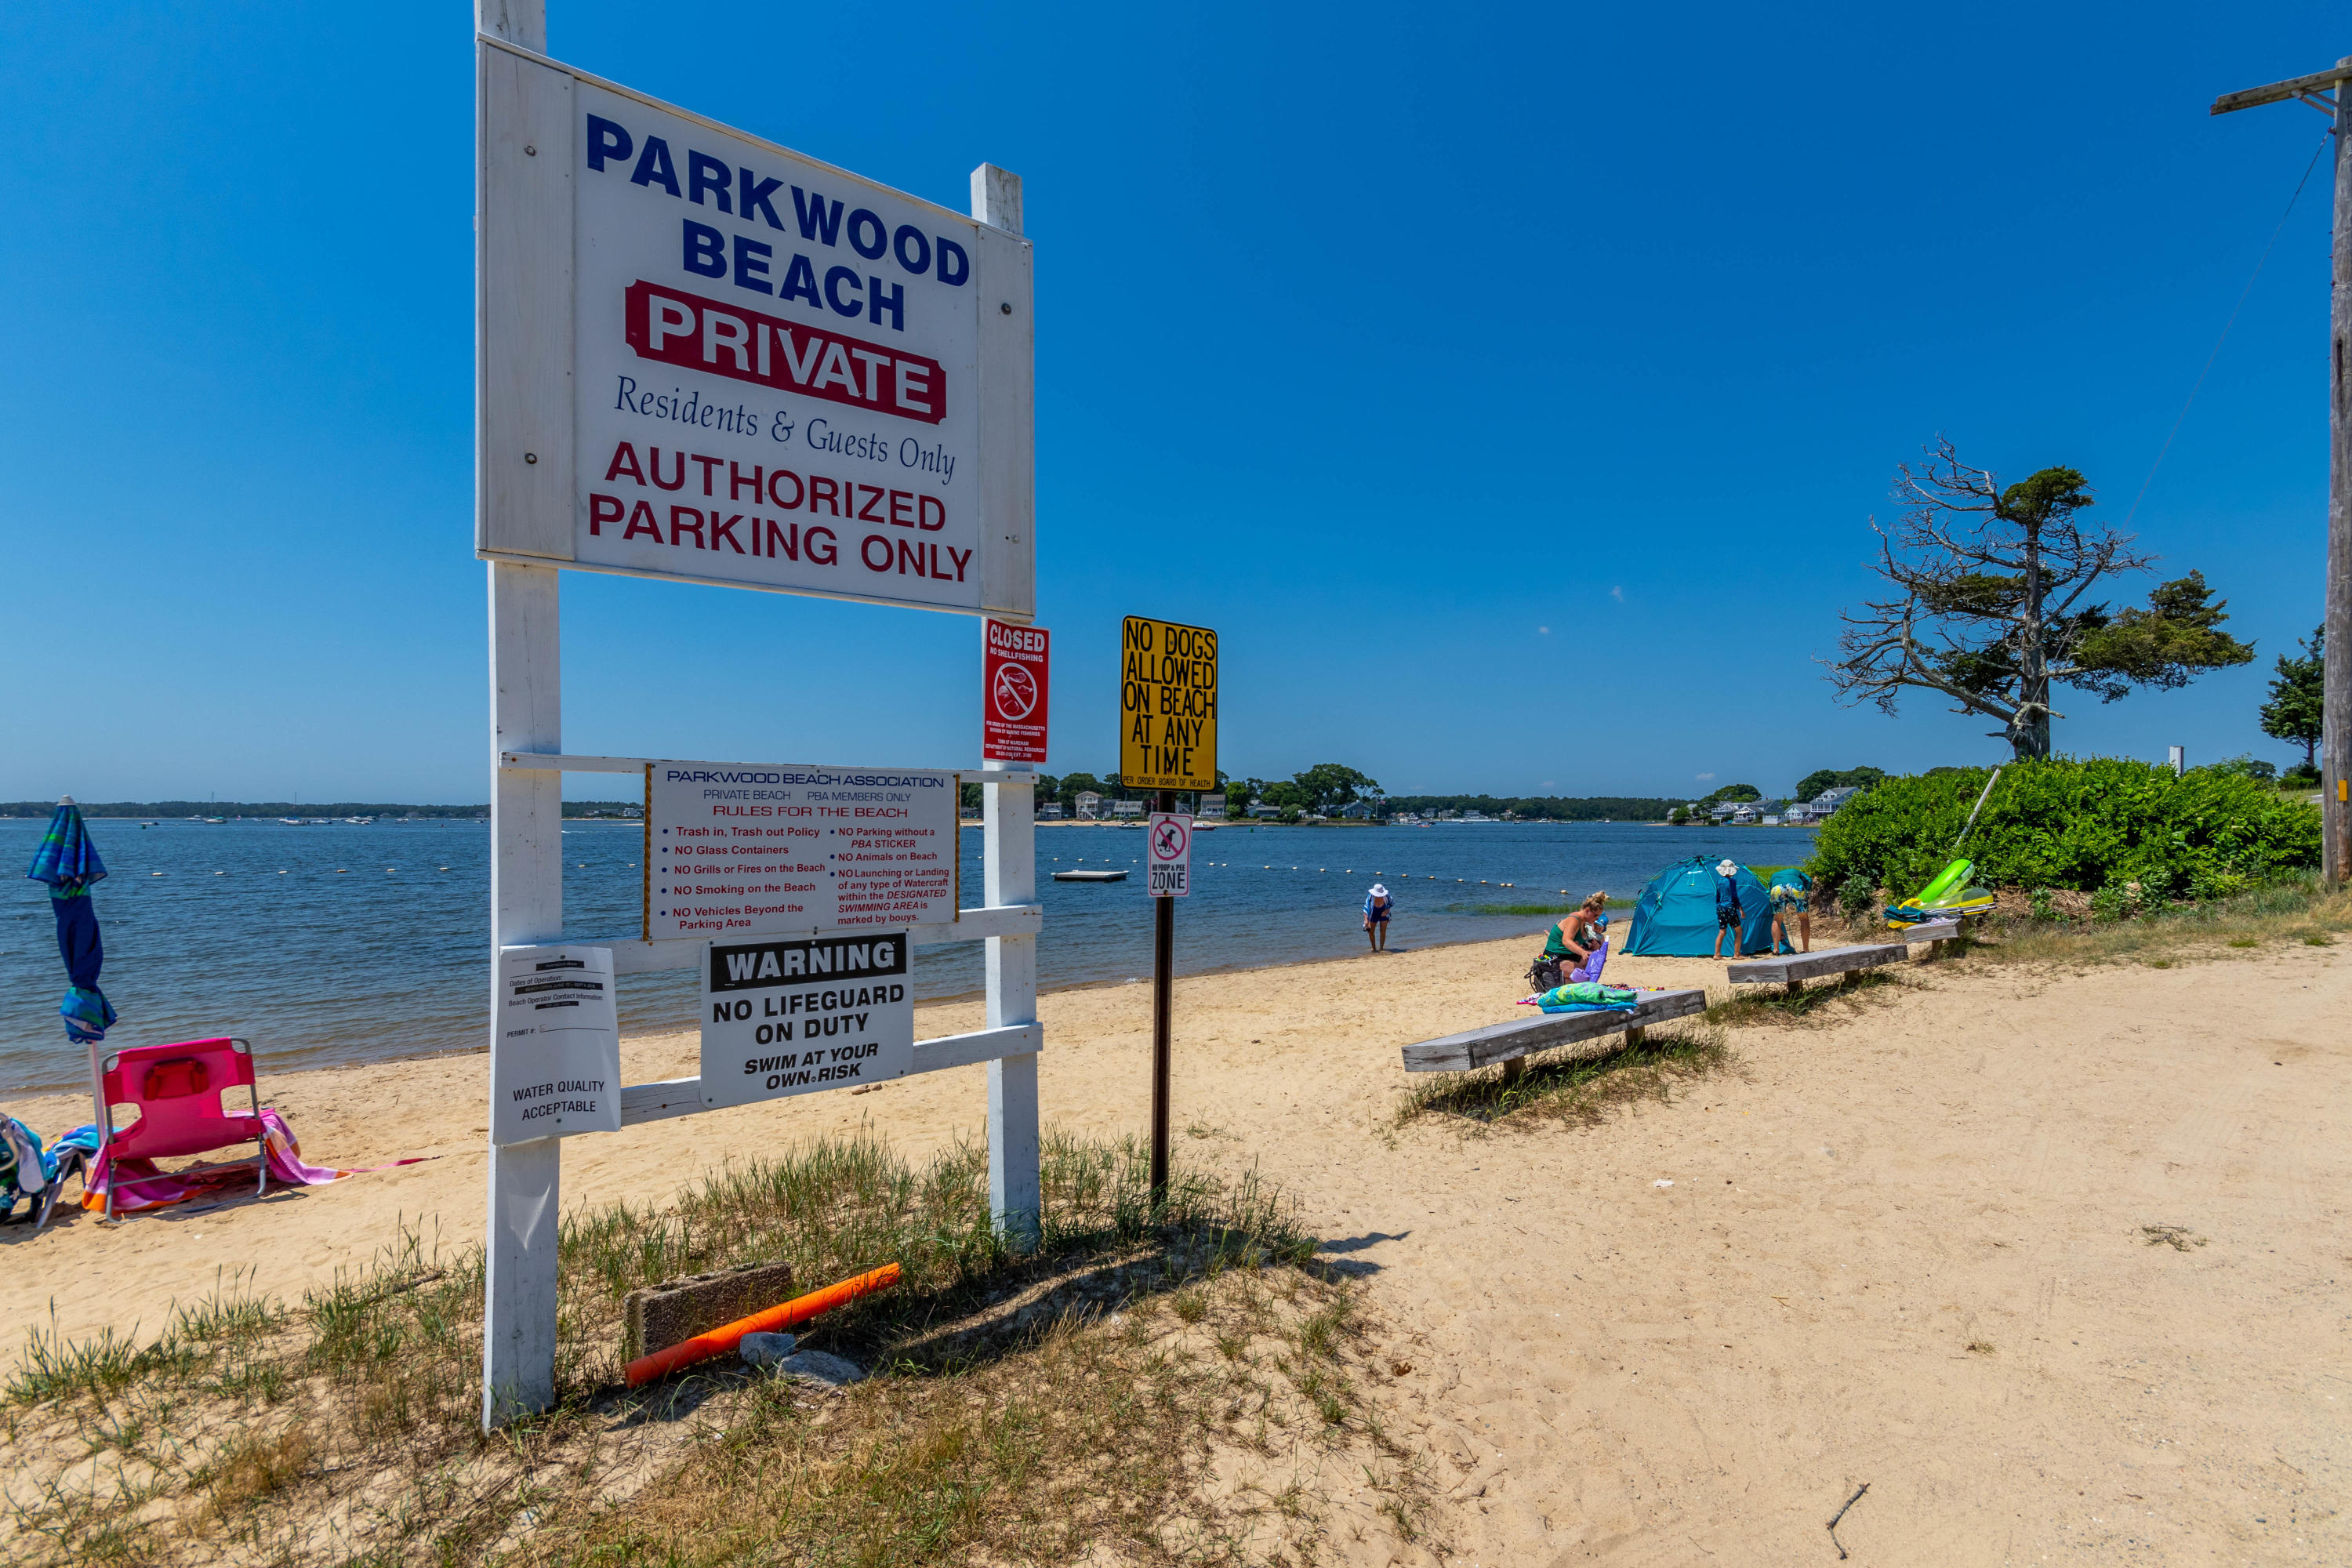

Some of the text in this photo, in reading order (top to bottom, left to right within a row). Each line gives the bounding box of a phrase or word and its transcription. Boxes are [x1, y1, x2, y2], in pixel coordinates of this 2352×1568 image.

[586, 113, 970, 287] PARKWOOD
[682, 218, 905, 332] BEACH
[648, 294, 931, 414] PRIVATE
[614, 376, 956, 485] Residents & Guests Only
[604, 441, 946, 532] AUTHORIZED
[590, 493, 972, 583] PARKING ONLY
[990, 624, 1044, 652] CLOSED
[1126, 620, 1215, 661] NO DOGS
[998, 649, 1043, 662] SHELLFISHING
[1127, 652, 1214, 690] ALLOWED
[1123, 681, 1215, 719] ON BEACH
[1132, 713, 1203, 747] AT ANY
[1141, 745, 1194, 776] TIME
[667, 771, 944, 787] PARKWOOD BEACH ASSOCIATION
[1138, 776, 1155, 785] ORDER
[703, 789, 911, 802] PRIVATE BEACH PBA MEMBERS ONLY
[713, 805, 908, 818] RULES FOR THE BEACH
[676, 826, 820, 838] Trash in, Trash out Policy
[856, 828, 892, 837] Parking
[675, 844, 789, 855] NO Glass Containers
[674, 865, 691, 874] NO
[694, 865, 720, 873] Grills
[797, 863, 826, 872] Beach
[855, 869, 902, 878] Launching
[916, 868, 949, 877] Landing
[838, 880, 848, 890] of
[870, 880, 890, 891] type
[904, 878, 949, 887] Watercraft
[1152, 872, 1185, 889] ZONE
[674, 886, 691, 895] NO
[695, 884, 744, 895] Smoking
[764, 884, 781, 892] the
[784, 883, 816, 892] Beach
[838, 889, 947, 901] within the DESIGNATED
[673, 904, 804, 917] NO Vehicles Beyond the
[837, 902, 891, 913] SWIMMING
[892, 902, 919, 910] AREA
[679, 919, 751, 930] Parking Area
[837, 914, 919, 924] marked by bouys.
[726, 941, 895, 982] WARNING
[535, 975, 563, 985] Operation:
[528, 996, 552, 1004] Operator
[713, 983, 905, 1023] NO LIFEGUARD
[506, 1029, 528, 1038] PERMIT
[755, 1012, 869, 1045] ON DUTY
[744, 1043, 879, 1075] SWIM AT YOUR
[766, 1062, 862, 1089] OWN RISK
[513, 1080, 604, 1102] WATER QUALITY
[522, 1101, 596, 1121] ACCEPTABLE
